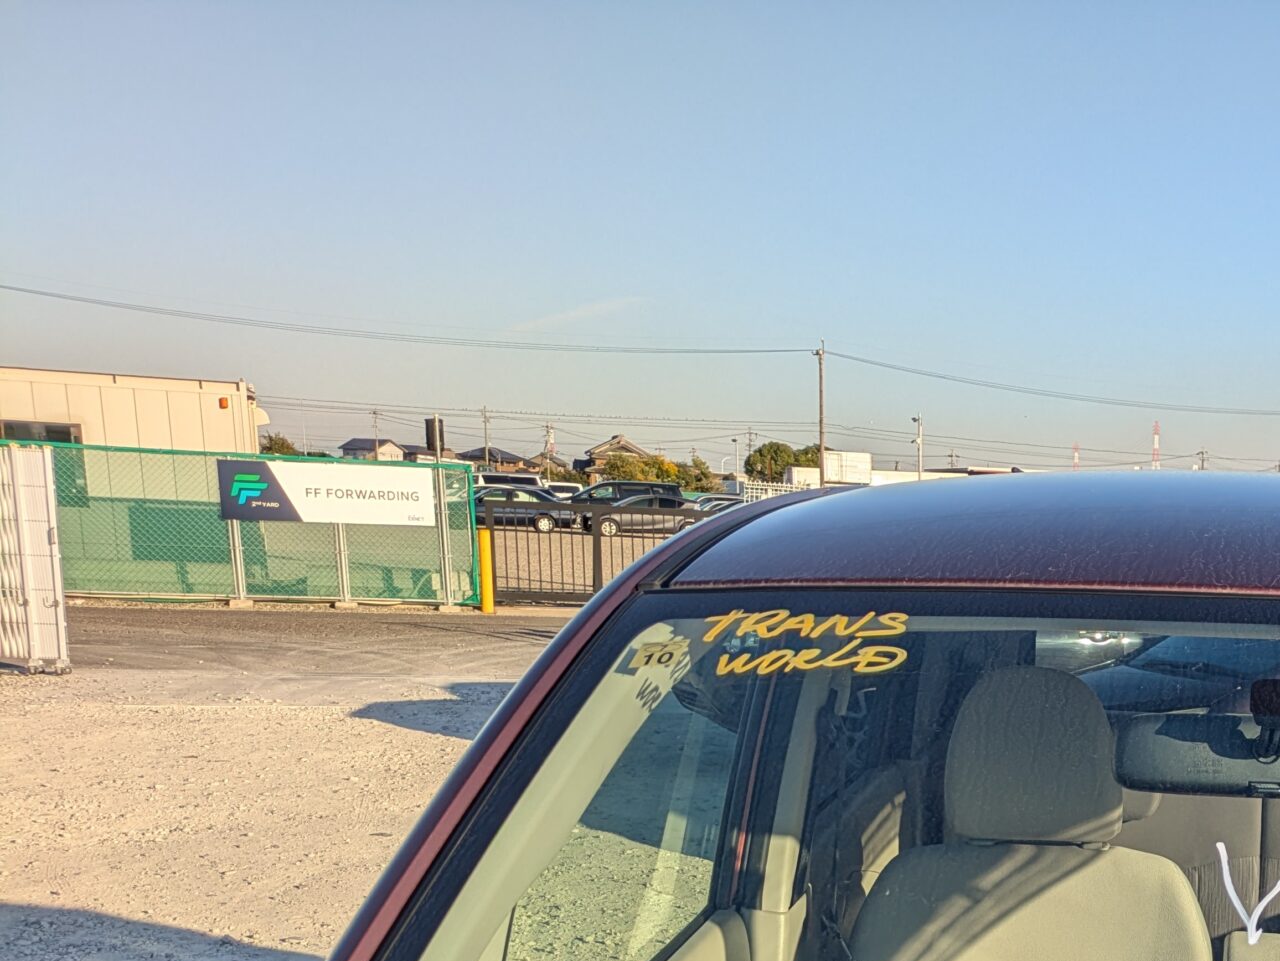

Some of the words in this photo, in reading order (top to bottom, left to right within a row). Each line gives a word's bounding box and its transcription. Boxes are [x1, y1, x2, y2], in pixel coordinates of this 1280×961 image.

[305, 487, 321, 498] FF
[326, 488, 420, 502] FORWARDING
[702, 608, 910, 643] TRANS
[643, 651, 675, 666] 10
